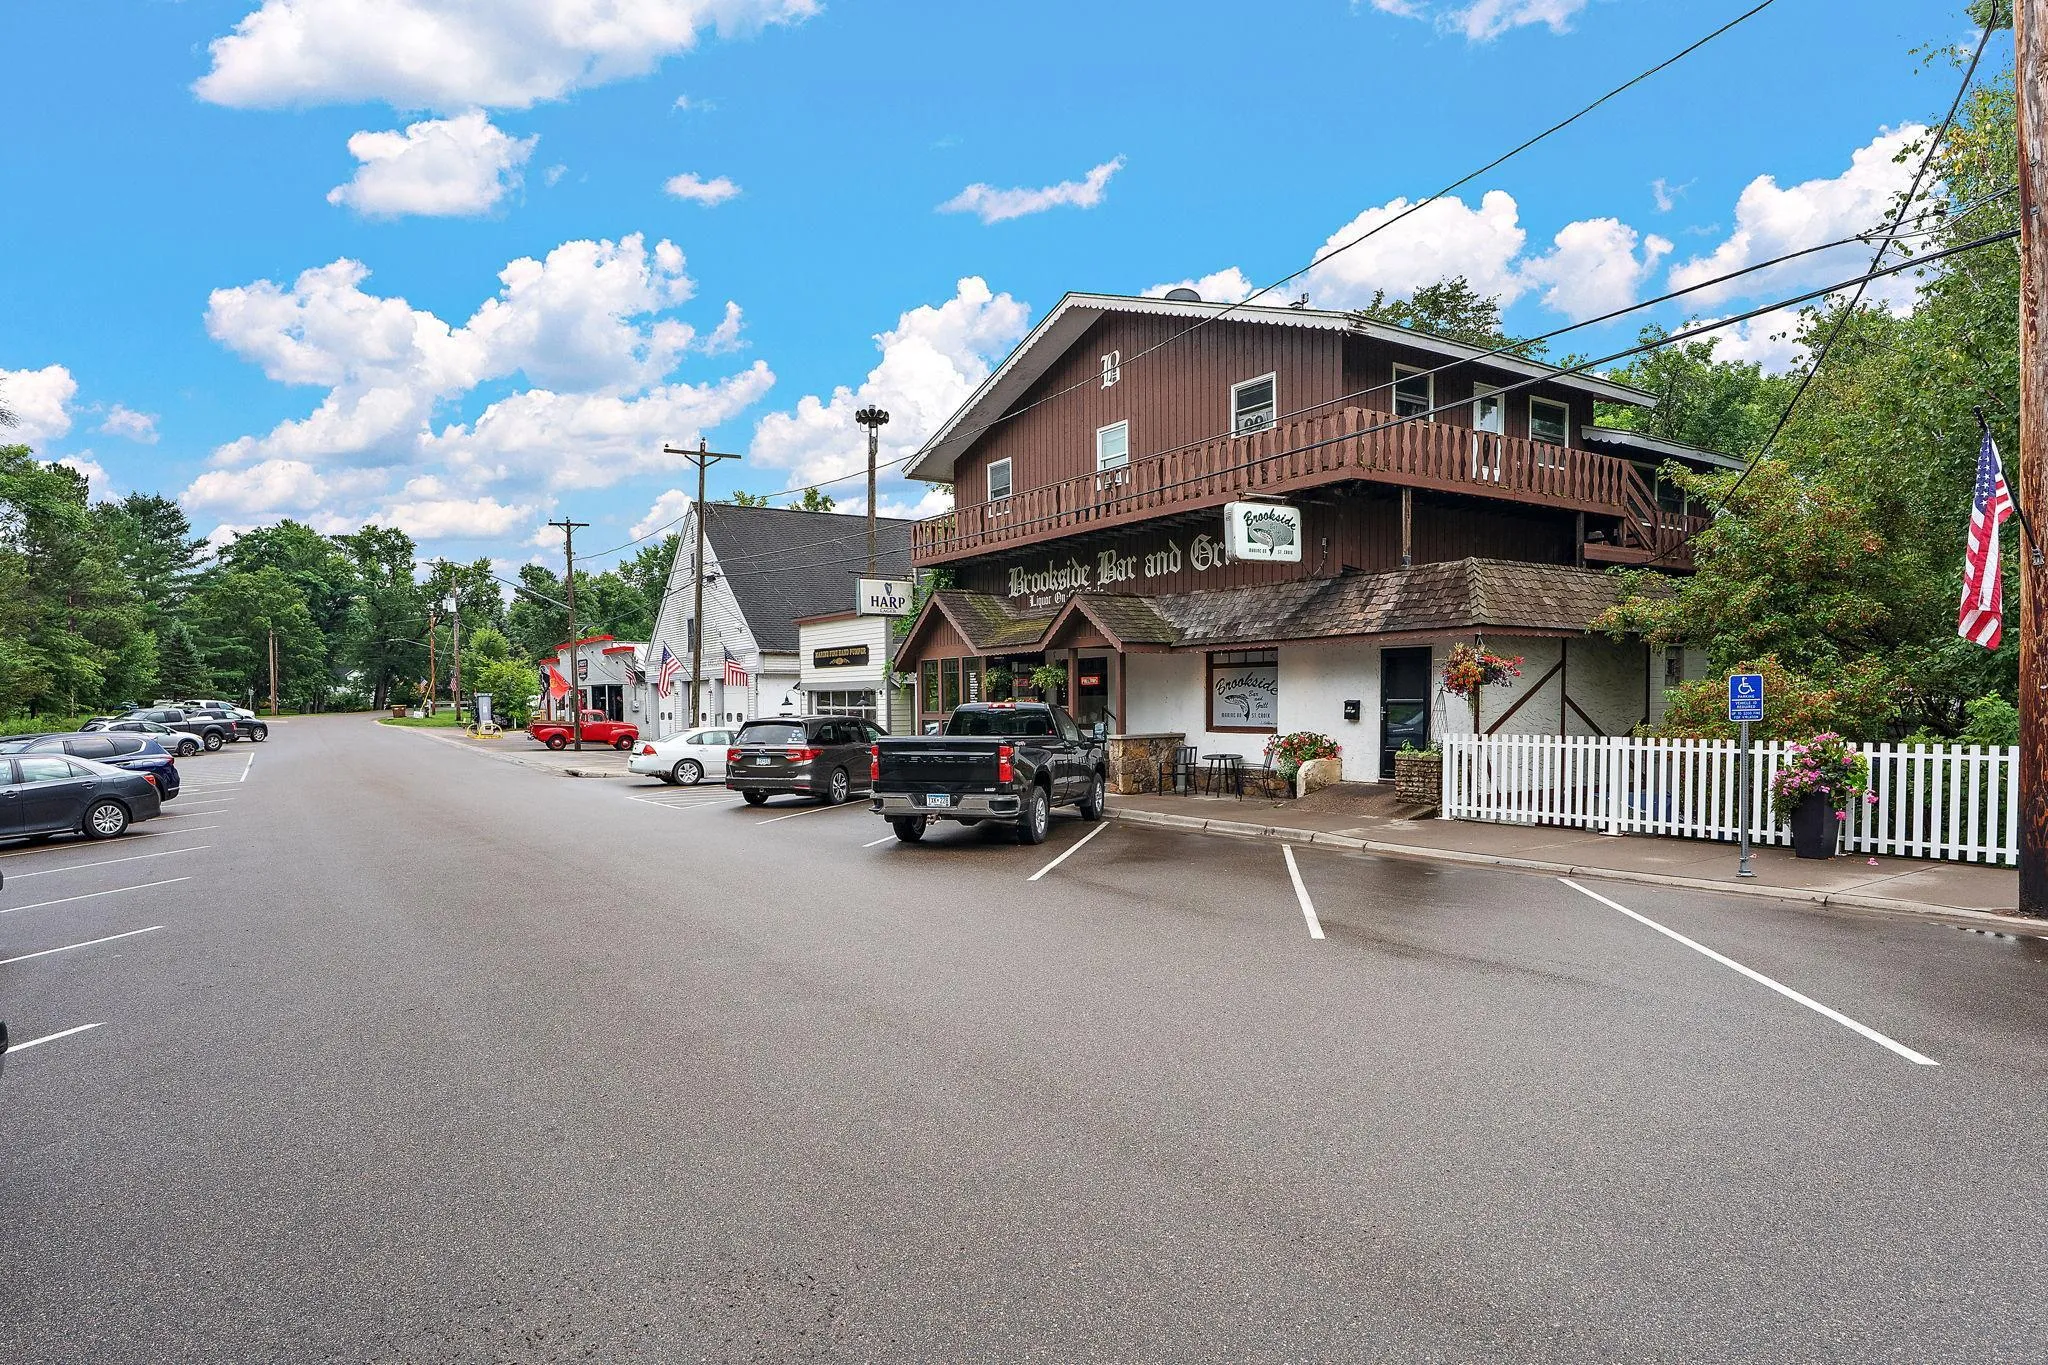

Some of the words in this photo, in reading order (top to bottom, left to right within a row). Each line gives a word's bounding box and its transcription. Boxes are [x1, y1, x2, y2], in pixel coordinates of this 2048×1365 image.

[1244, 508, 1296, 530] Brookside
[1008, 557, 1091, 598] Brookside
[1097, 549, 1137, 586] Bar
[1144, 539, 1182, 578] and
[871, 596, 906, 609] HARP
[1029, 593, 1052, 609] Liquor
[1215, 672, 1278, 695] Brookside
